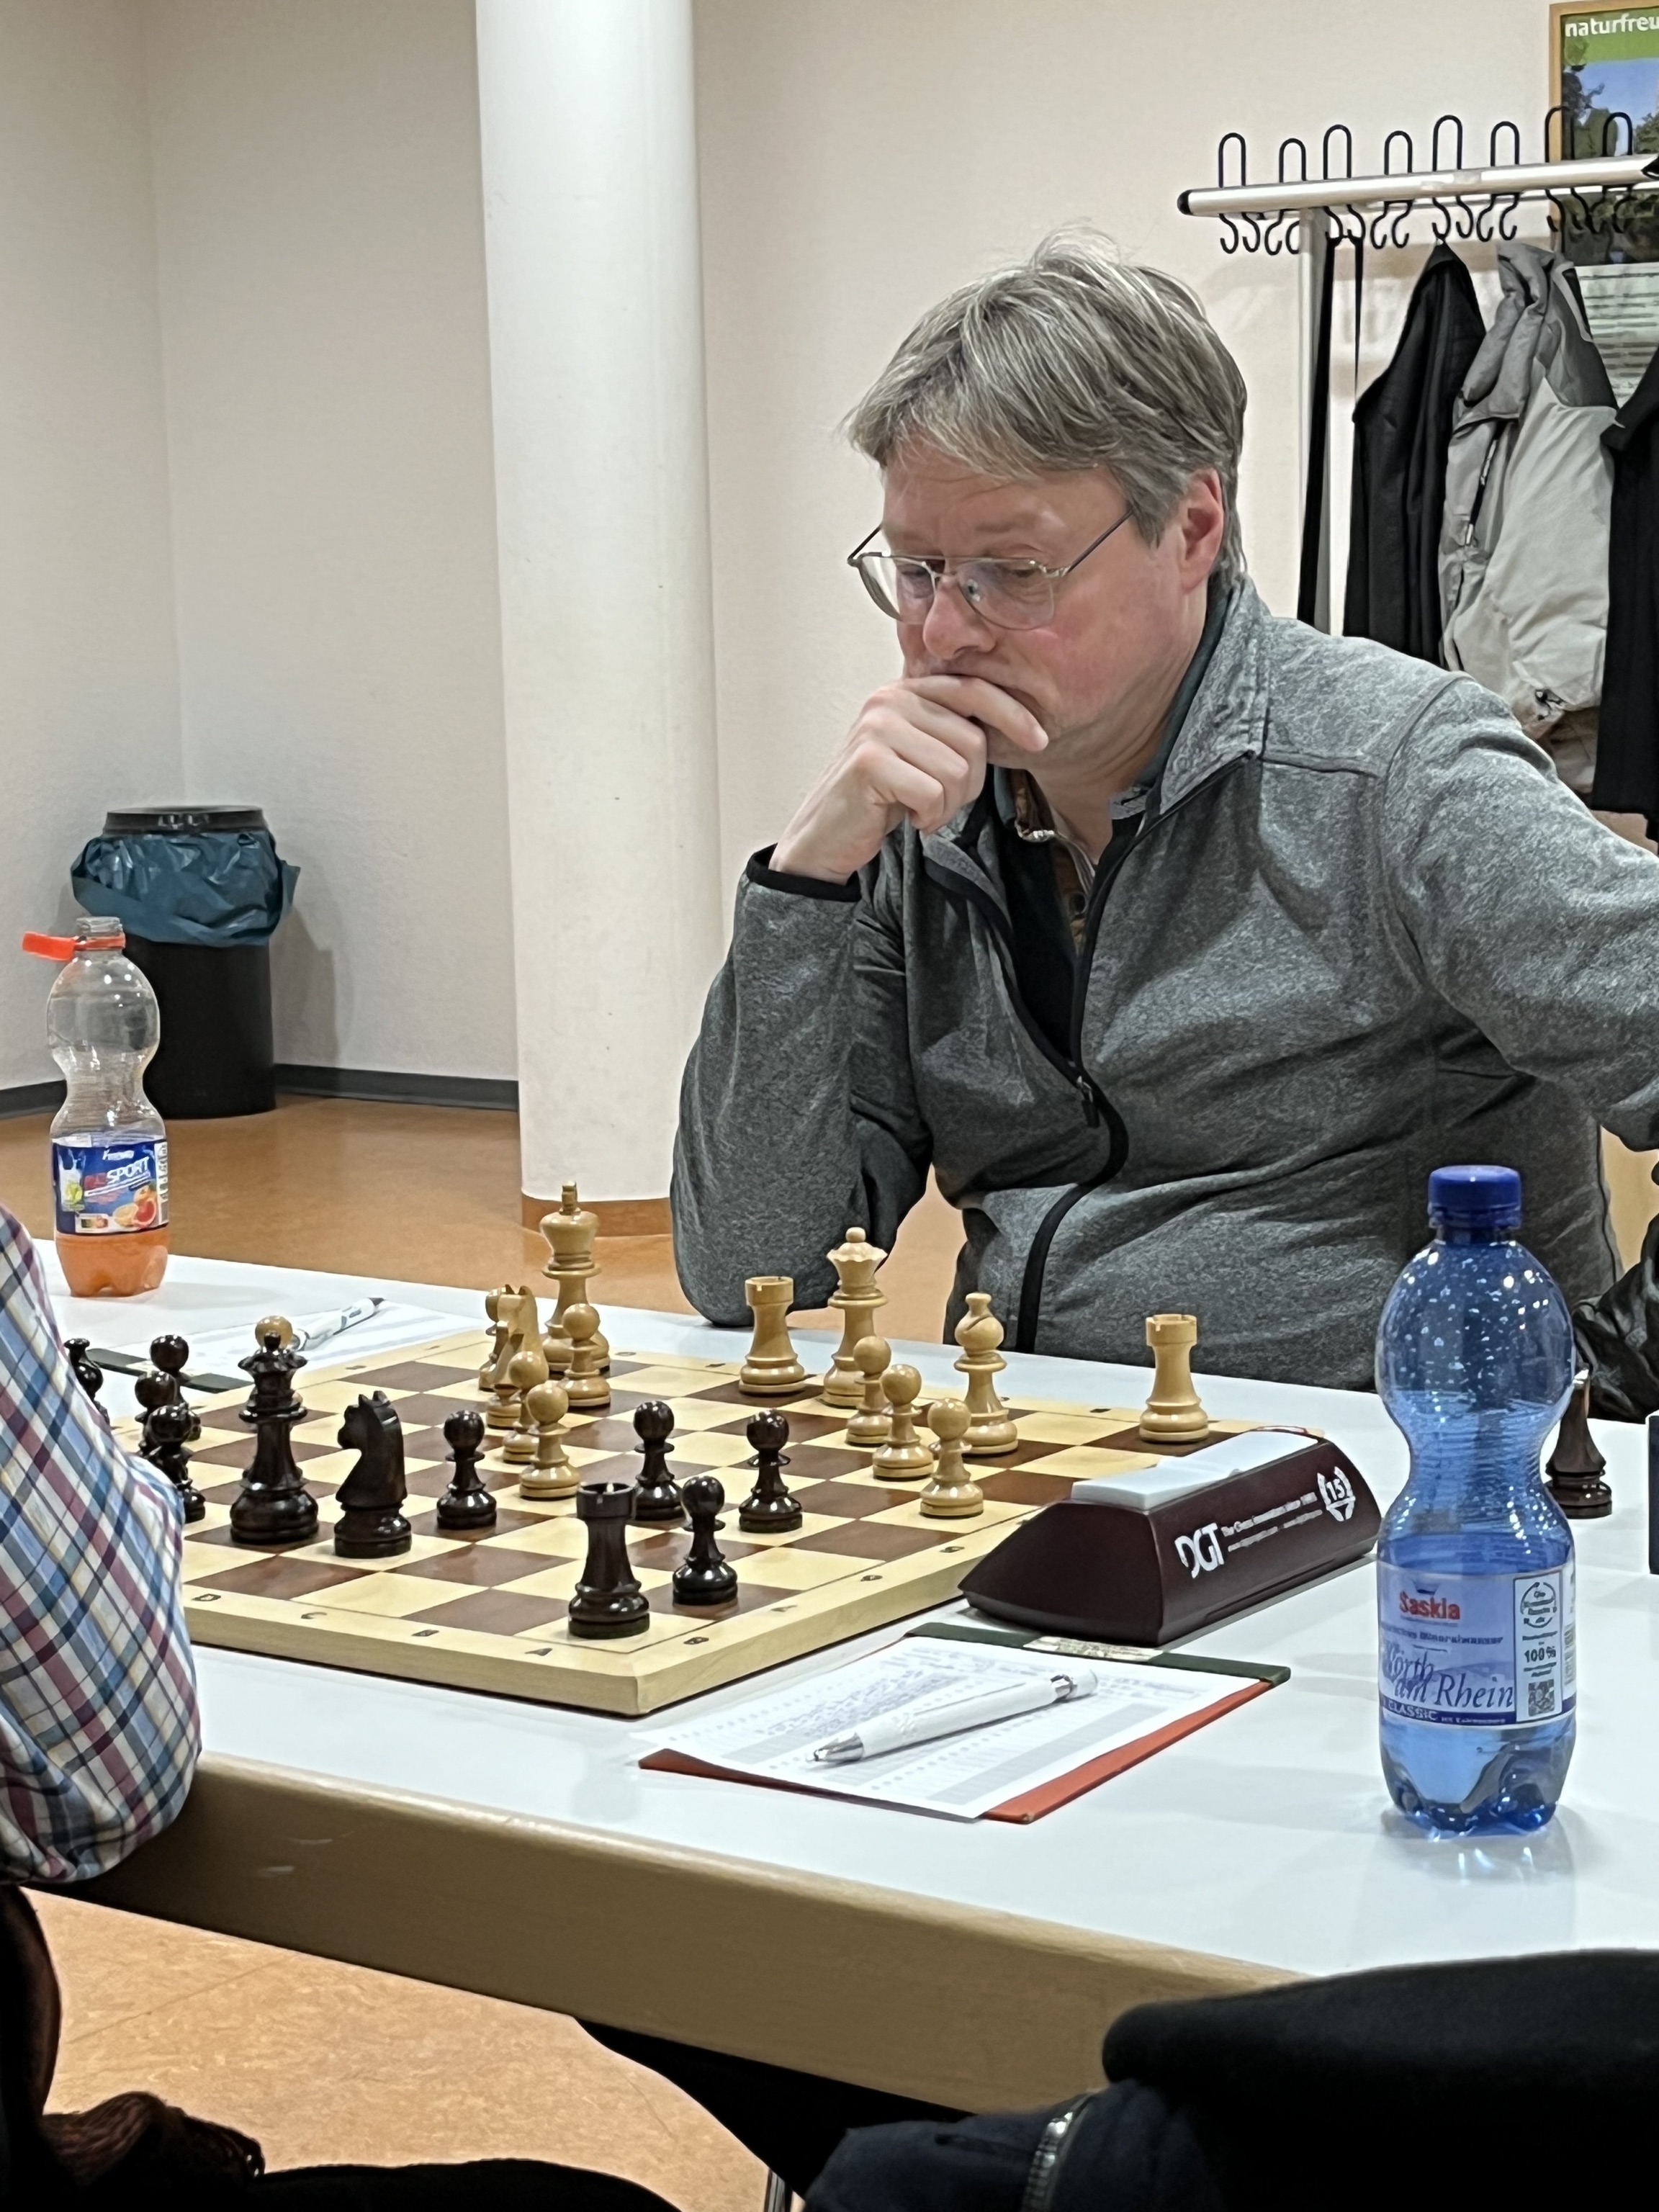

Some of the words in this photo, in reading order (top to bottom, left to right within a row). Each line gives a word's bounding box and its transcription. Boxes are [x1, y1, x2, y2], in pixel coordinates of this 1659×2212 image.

[1174, 1522, 1225, 1578] DGT
[1399, 1591, 1461, 1620] Saskia
[1434, 1672, 1513, 1708] Rhein
